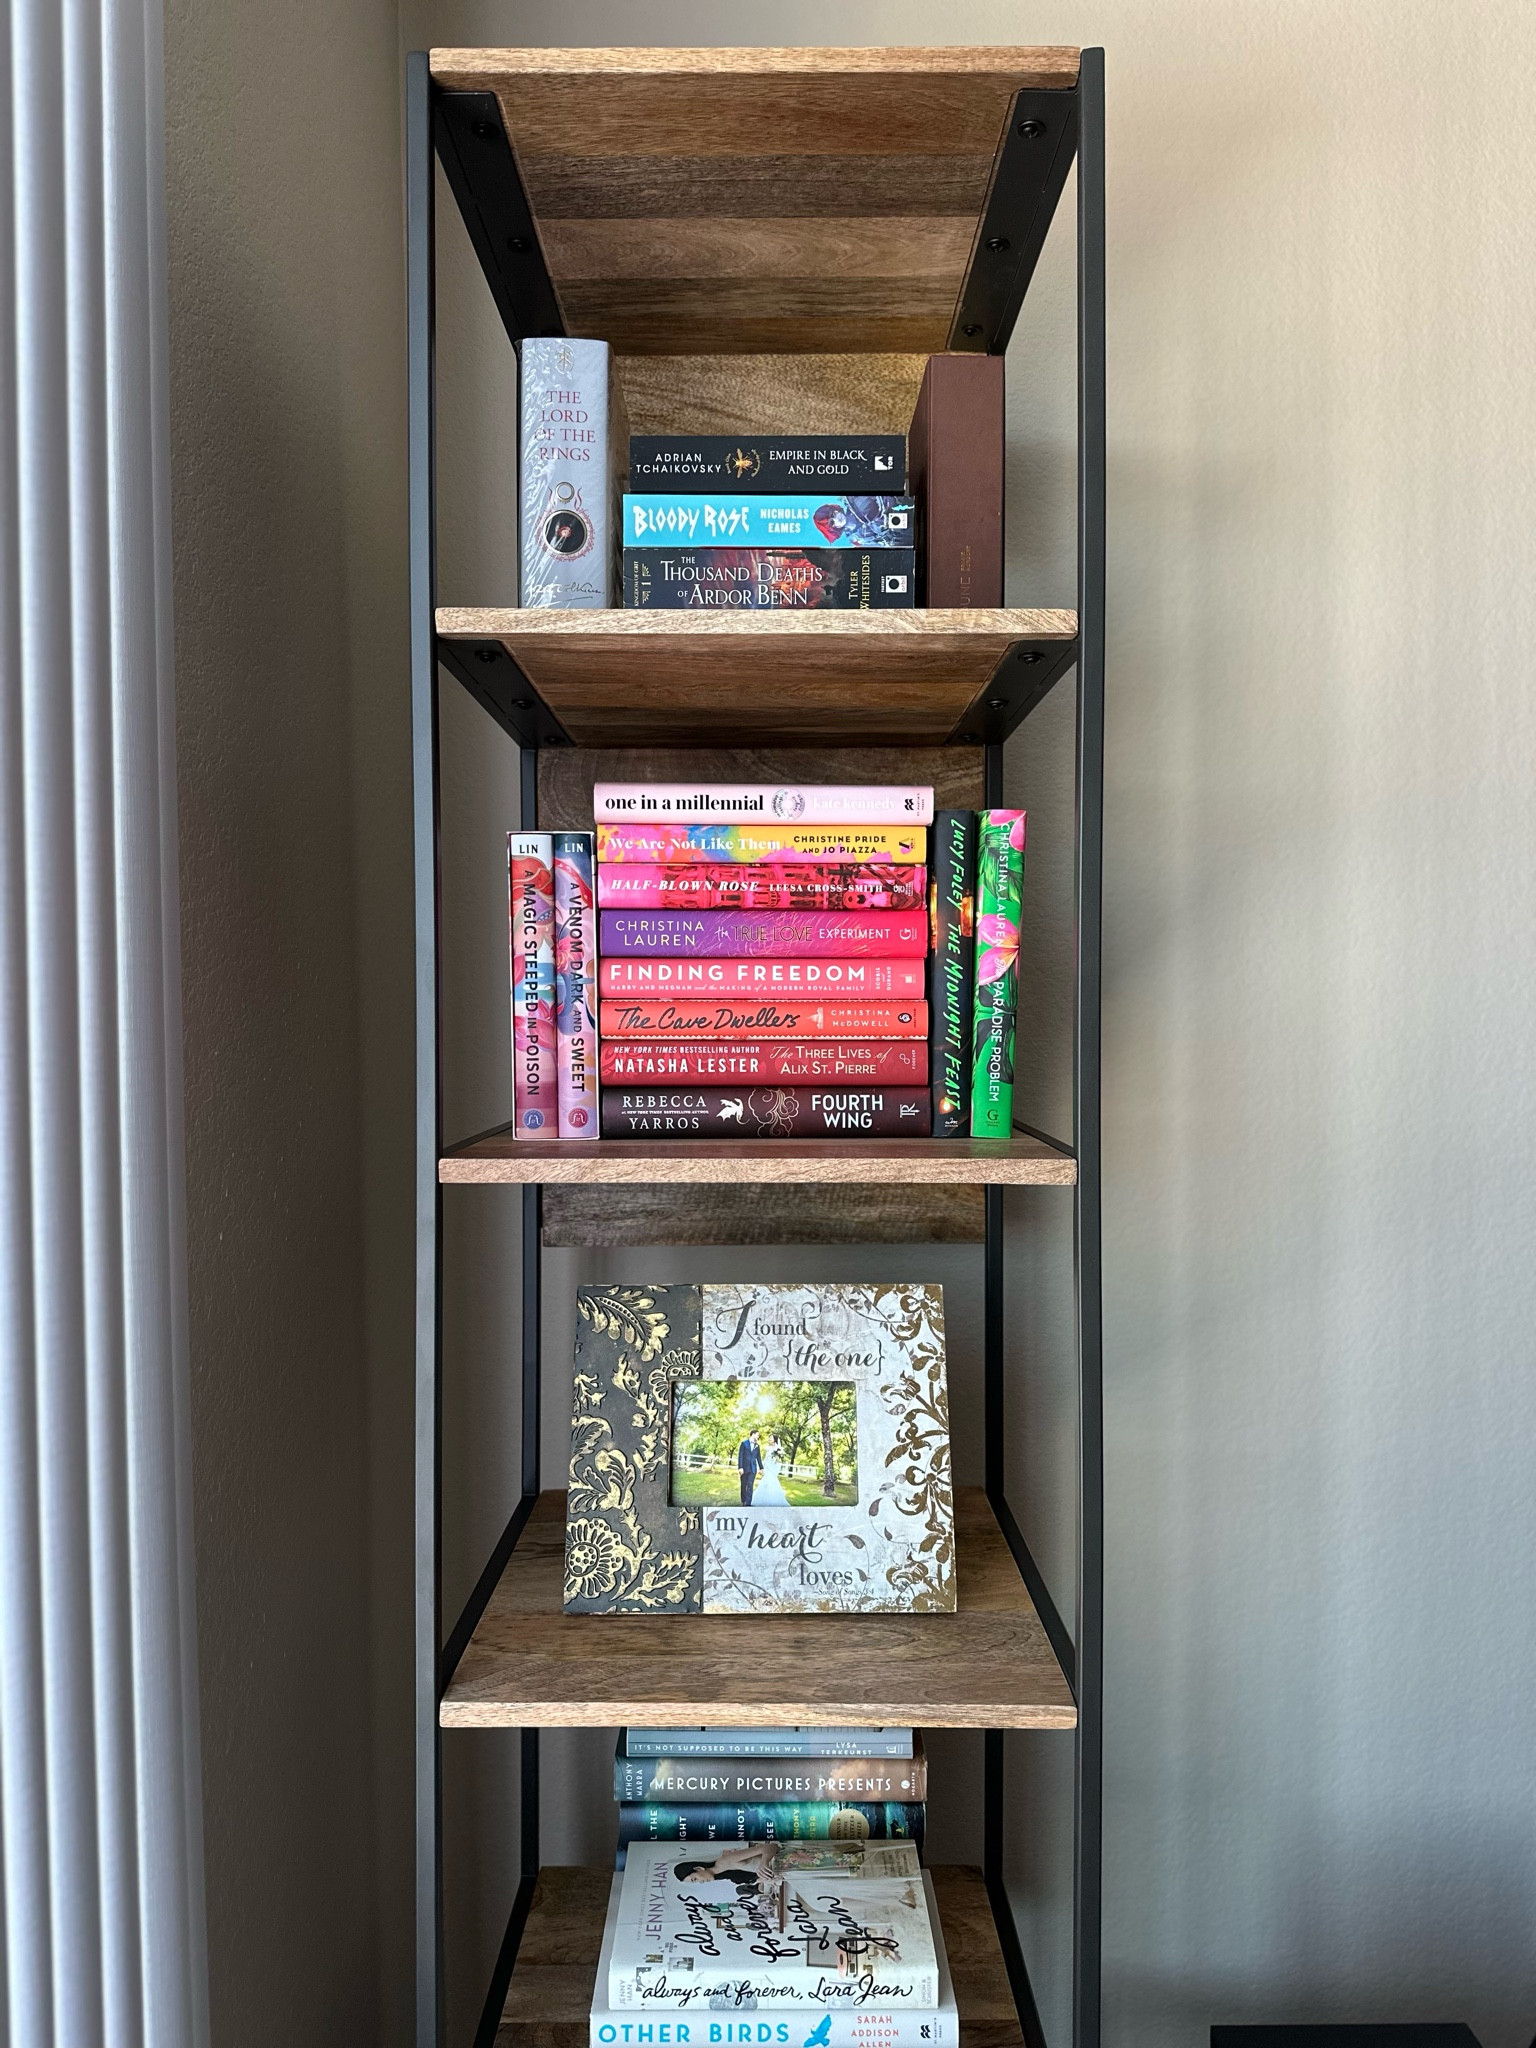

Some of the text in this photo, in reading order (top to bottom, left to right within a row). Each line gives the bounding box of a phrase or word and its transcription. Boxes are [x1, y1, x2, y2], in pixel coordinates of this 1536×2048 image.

[546, 390, 581, 405] THE
[541, 409, 588, 424] LORD
[534, 428, 596, 444] OF THE
[539, 447, 590, 462] RINGS
[655, 453, 702, 463] ADRIAN
[769, 450, 867, 461] EMPIRE IN BLACK
[636, 464, 721, 474] TCHAIKOVSKY
[788, 465, 849, 475] AND GOLD
[632, 504, 750, 539] BLOODY ROSE
[760, 508, 809, 520] NICHOLAS
[768, 522, 801, 533] EAMES
[681, 556, 696, 564] THE
[660, 560, 823, 582] THOUSAND DEATHS
[849, 570, 858, 600] TYLER
[860, 554, 871, 609] WHITESIDES
[677, 583, 808, 605] OF ARDOR BENN
[605, 798, 637, 810] one
[641, 794, 657, 810] in
[662, 798, 671, 810] a
[676, 794, 764, 811] millennial
[813, 797, 841, 810] kate
[843, 797, 895, 812] kennedy
[519, 844, 538, 854] LIN
[564, 843, 584, 853] LIN
[609, 837, 781, 851] We Are Not Like Them
[823, 846, 836, 854] JO
[839, 846, 877, 854] PIAZZA
[997, 823, 1010, 892] CHRISTINA
[610, 879, 759, 892] HALF-BLOWN ROSE
[769, 883, 883, 892] LEESA CROSS-SMITH
[569, 895, 583, 953] VENOM
[615, 920, 705, 931] CHRISTINA
[994, 897, 1007, 947] LAUREN
[624, 935, 696, 946] LAUREN
[715, 926, 891, 942] the TRUE LOVE EXPERIMENT
[947, 923, 962, 955] THE
[610, 964, 865, 981] FINDING FREEDOM
[523, 870, 540, 1095] A MAGIC STEEPED IN POISON
[570, 961, 584, 1004] DARK
[754, 984, 763, 992] of
[943, 958, 964, 1049] MIDNIGHT
[992, 981, 1005, 1043] PARADISE
[573, 1009, 582, 1033] AND
[614, 1006, 801, 1030] The Cave Dwellers
[614, 1046, 631, 1054] NEW
[633, 1046, 652, 1054] YORK
[655, 1046, 677, 1054] TIMES
[679, 1046, 728, 1054] BESTSELLING
[770, 1045, 893, 1064] The THREE LIVES of
[571, 1037, 585, 1092] SWEET
[614, 1058, 759, 1073] NATASHA LESTER
[780, 1061, 877, 1074] ALIX ST. PIERRE
[989, 1042, 1002, 1102] PROBLEM
[944, 1052, 962, 1110] FEAST
[622, 1095, 707, 1108] REBECCA
[811, 1094, 883, 1111] FOURTH
[628, 1117, 700, 1129] YARROS
[823, 1112, 873, 1129] WING
[753, 1311, 814, 1336] found
[715, 1517, 748, 1539] my
[747, 1522, 833, 1577] heart
[799, 1564, 853, 1586] loves
[625, 1763, 633, 1800] ANTHONY
[655, 1777, 892, 1791] MERCURY PICTURES PRESENTS
[650, 1809, 658, 1831] THE
[679, 1816, 687, 1840] IGHT
[709, 1824, 716, 1839] WE
[645, 1862, 668, 1940] JENNY HAN
[674, 1893, 721, 1957] always
[710, 1910, 743, 1942] and
[787, 1898, 829, 1951] Lara
[817, 1896, 899, 1954] Jean
[642, 1974, 913, 2007] always and forever, Lara Jean
[857, 2016, 892, 2024] SARAH
[598, 2023, 789, 2043] OTHER BIRDS
